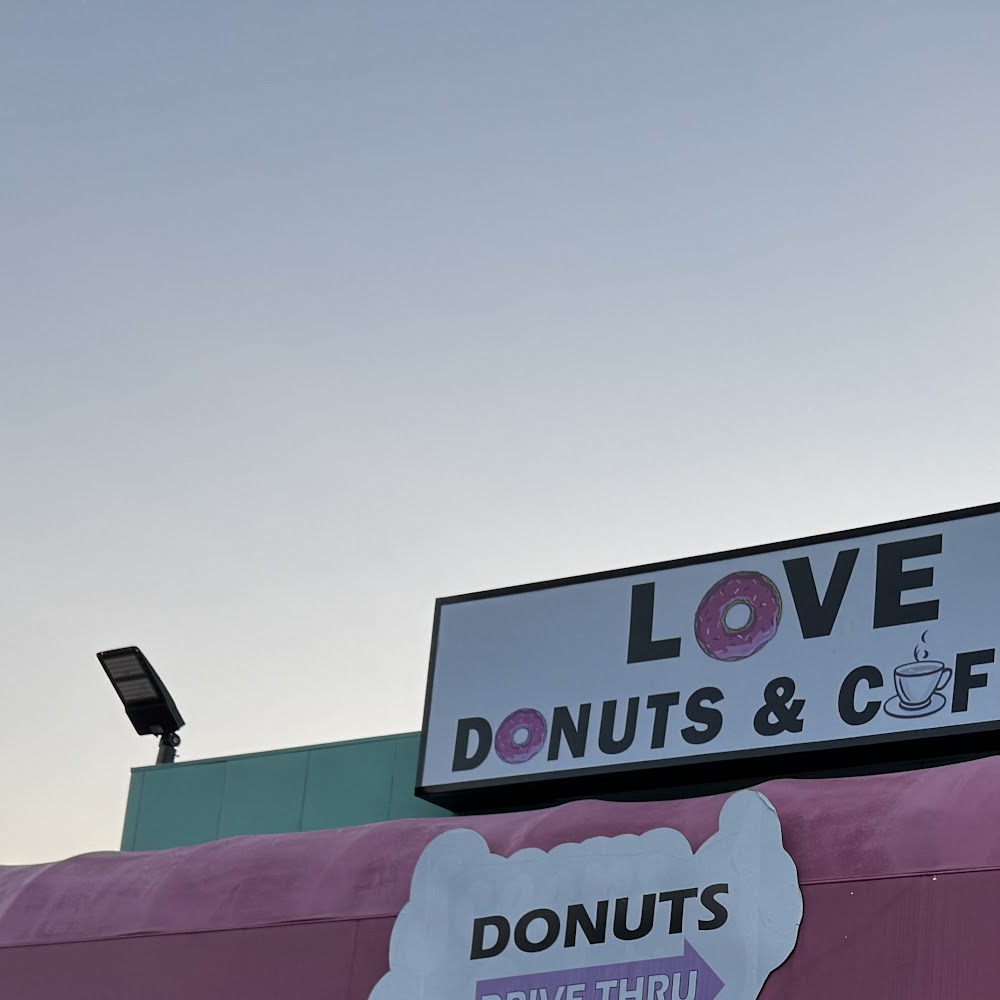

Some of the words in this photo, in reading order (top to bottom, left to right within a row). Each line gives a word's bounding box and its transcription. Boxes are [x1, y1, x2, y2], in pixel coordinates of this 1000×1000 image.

[627, 533, 943, 665] LOVE
[452, 686, 725, 772] DONUTS
[753, 676, 806, 737] &
[470, 883, 729, 960] DONUTS
